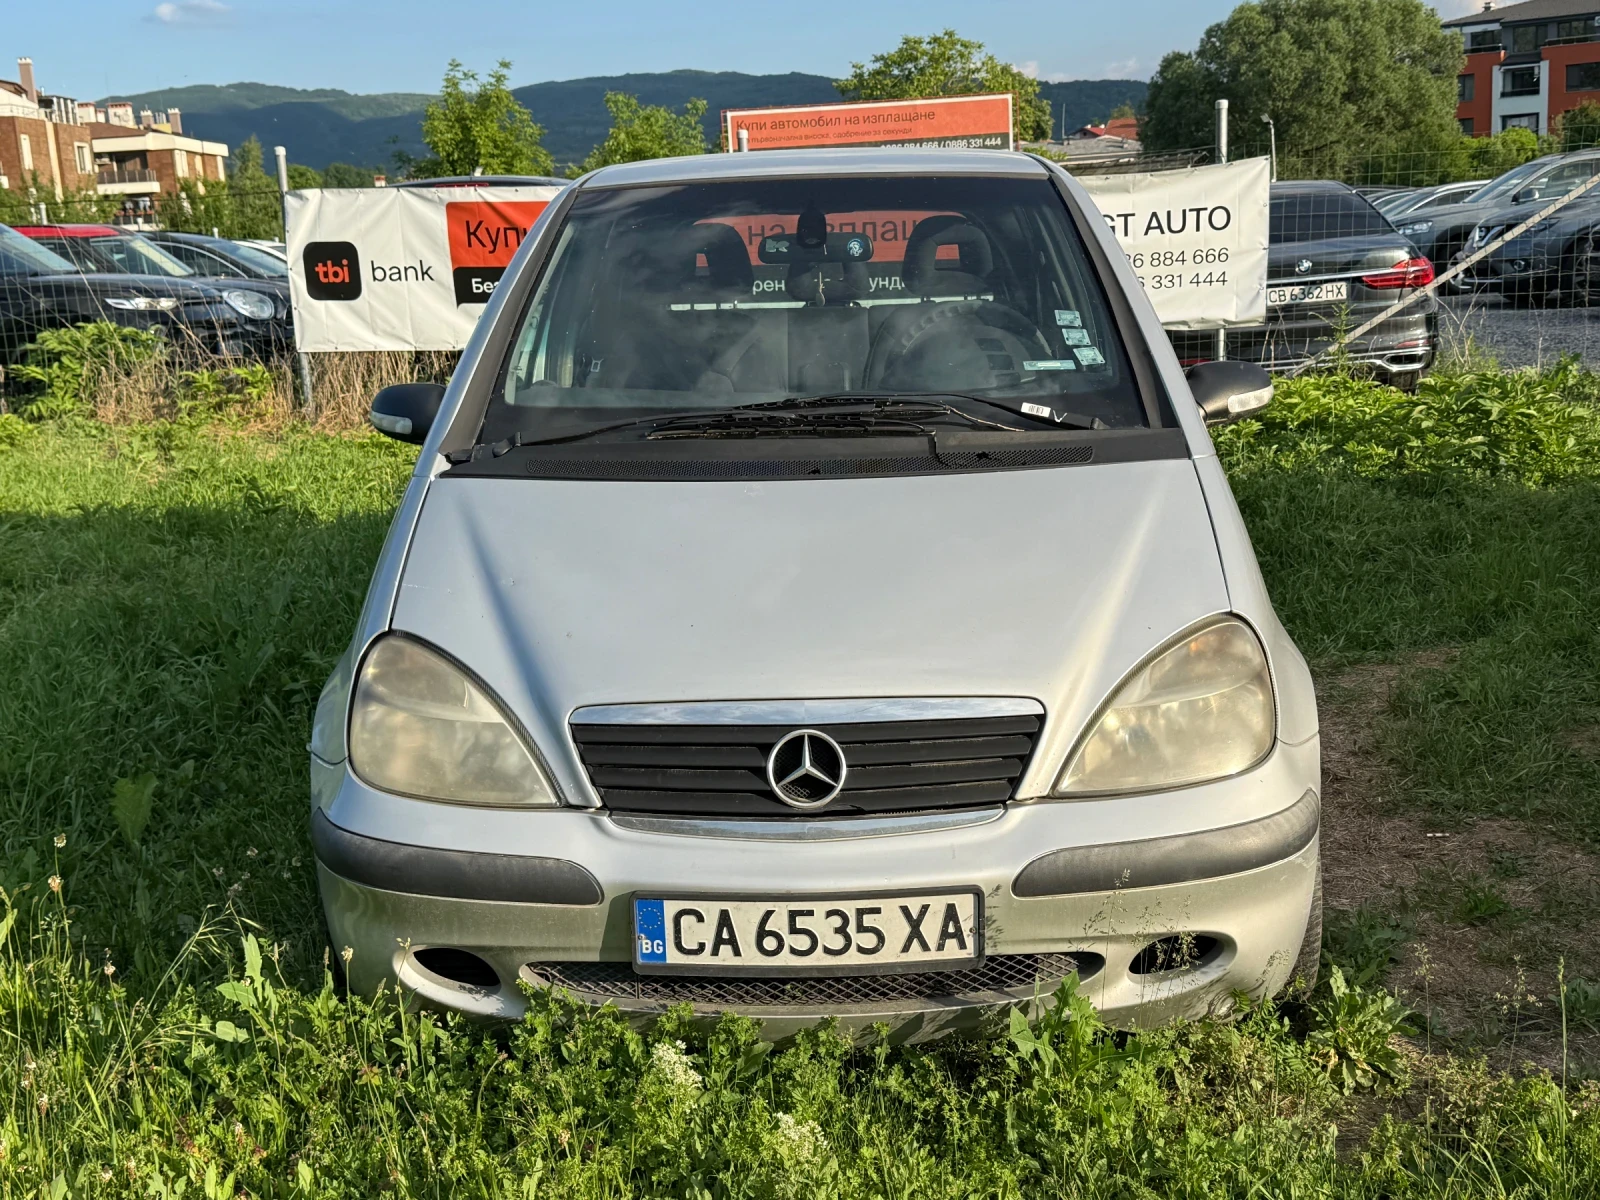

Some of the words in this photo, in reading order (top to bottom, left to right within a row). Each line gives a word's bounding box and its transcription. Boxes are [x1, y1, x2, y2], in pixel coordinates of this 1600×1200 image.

[736, 120, 767, 133] Купи
[770, 115, 841, 130] автомобил
[844, 116, 860, 126] на
[863, 110, 936, 125] изплащане
[969, 138, 983, 148] 331
[984, 137, 1002, 147] 444
[1143, 205, 1232, 237] AUTO
[465, 220, 529, 254] Куп
[1149, 250, 1187, 268] 884
[1192, 247, 1229, 265] 666
[314, 259, 351, 284] tbi
[370, 259, 435, 283] bank
[1151, 273, 1183, 290] 331
[1189, 270, 1229, 288] 444
[868, 276, 905, 292] унд
[1268, 289, 1287, 303] CB
[1290, 286, 1323, 302] 6362
[1325, 284, 1344, 299] HX
[672, 906, 743, 958] CA
[756, 905, 886, 958] 6535
[899, 902, 968, 954] XA
[642, 939, 664, 954] BG
